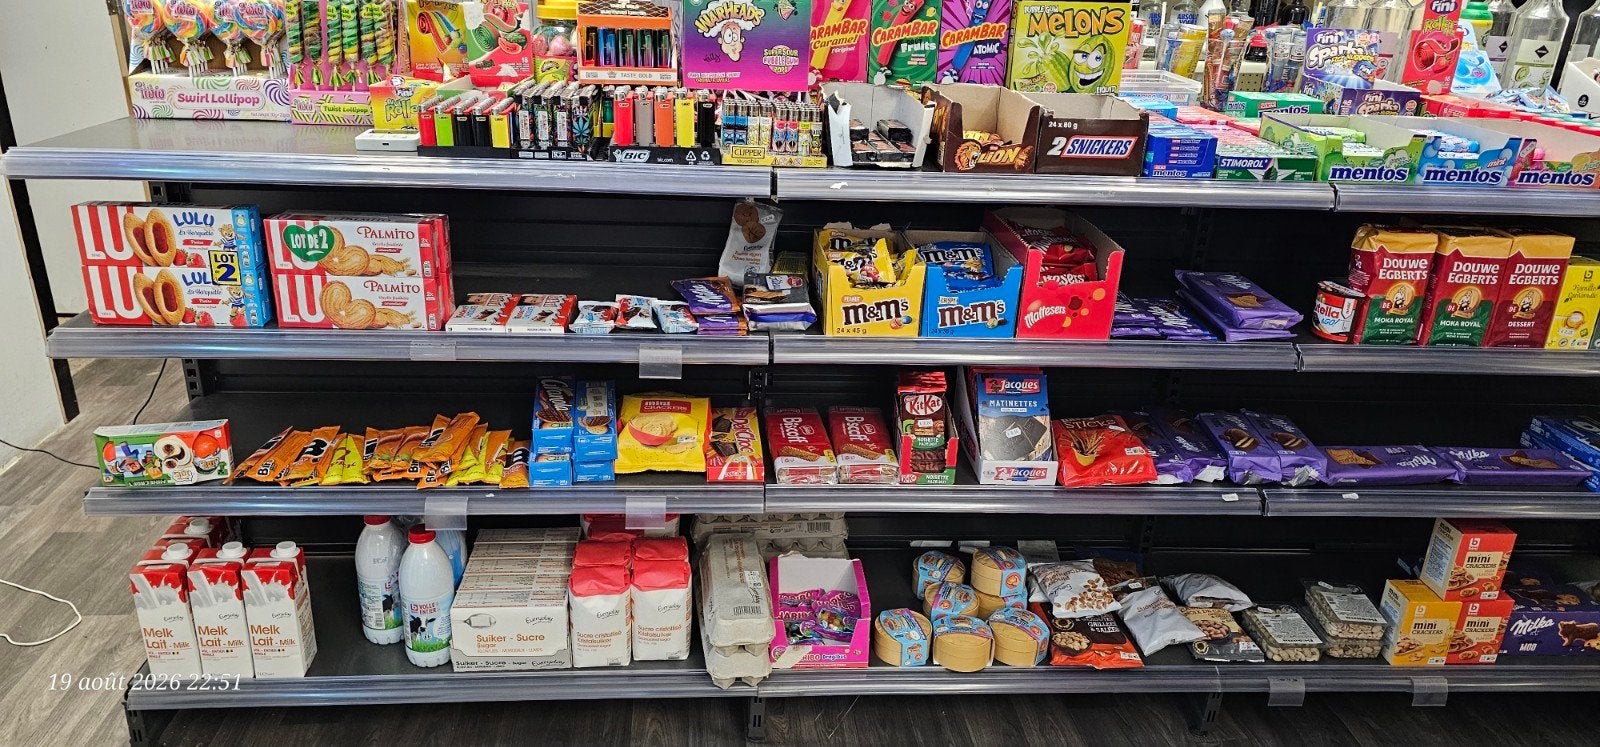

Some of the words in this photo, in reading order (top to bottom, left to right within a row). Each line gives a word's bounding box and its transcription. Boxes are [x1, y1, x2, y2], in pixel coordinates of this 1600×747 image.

[694, 2, 762, 32] WARHEADS
[812, 20, 868, 40] ARAMBAR
[974, 42, 1000, 55] ATOMIC
[177, 93, 209, 103] Swirl
[211, 93, 260, 106] Lollipop
[385, 103, 419, 122] Rolle
[734, 149, 762, 157] CLIPPER
[1048, 137, 1063, 156] 2
[1068, 139, 1132, 156] SNICKERS
[1221, 158, 1266, 168] STIMOROL
[1153, 169, 1188, 178] mentos
[1330, 167, 1408, 181] mentos
[1424, 168, 1502, 184] mentos
[1518, 170, 1595, 185] mentos
[173, 212, 215, 227] LULU
[290, 234, 307, 250] LOT
[308, 236, 320, 249] DE
[320, 229, 328, 250] 2
[214, 254, 235, 263] LOT
[182, 272, 213, 287] LUL
[216, 264, 238, 282] 2
[1378, 269, 1428, 281] EGBERTS
[1448, 272, 1499, 285] EGBERTS
[1509, 274, 1560, 286] EGBERTS
[842, 298, 909, 326] m&m's
[999, 380, 1038, 392] Jacques
[910, 394, 941, 414] KitKat
[783, 418, 808, 444] Biscoff
[845, 416, 871, 442] Biscoff
[1008, 468, 1046, 478] Jacques
[1467, 555, 1491, 564] mini
[198, 625, 228, 636] Melk
[250, 624, 280, 636] Melk
[1413, 621, 1438, 630] mini
[1466, 620, 1490, 628] mini
[1510, 615, 1555, 636] Milka
[143, 626, 174, 639] Melk
[476, 634, 507, 643] Suiker
[516, 634, 545, 642] Sucre
[145, 638, 167, 649] Lait
[173, 640, 190, 649] Milk
[200, 636, 222, 647] Lait
[227, 638, 244, 646] Milk
[252, 635, 273, 646] Lait
[279, 638, 296, 646] Milk
